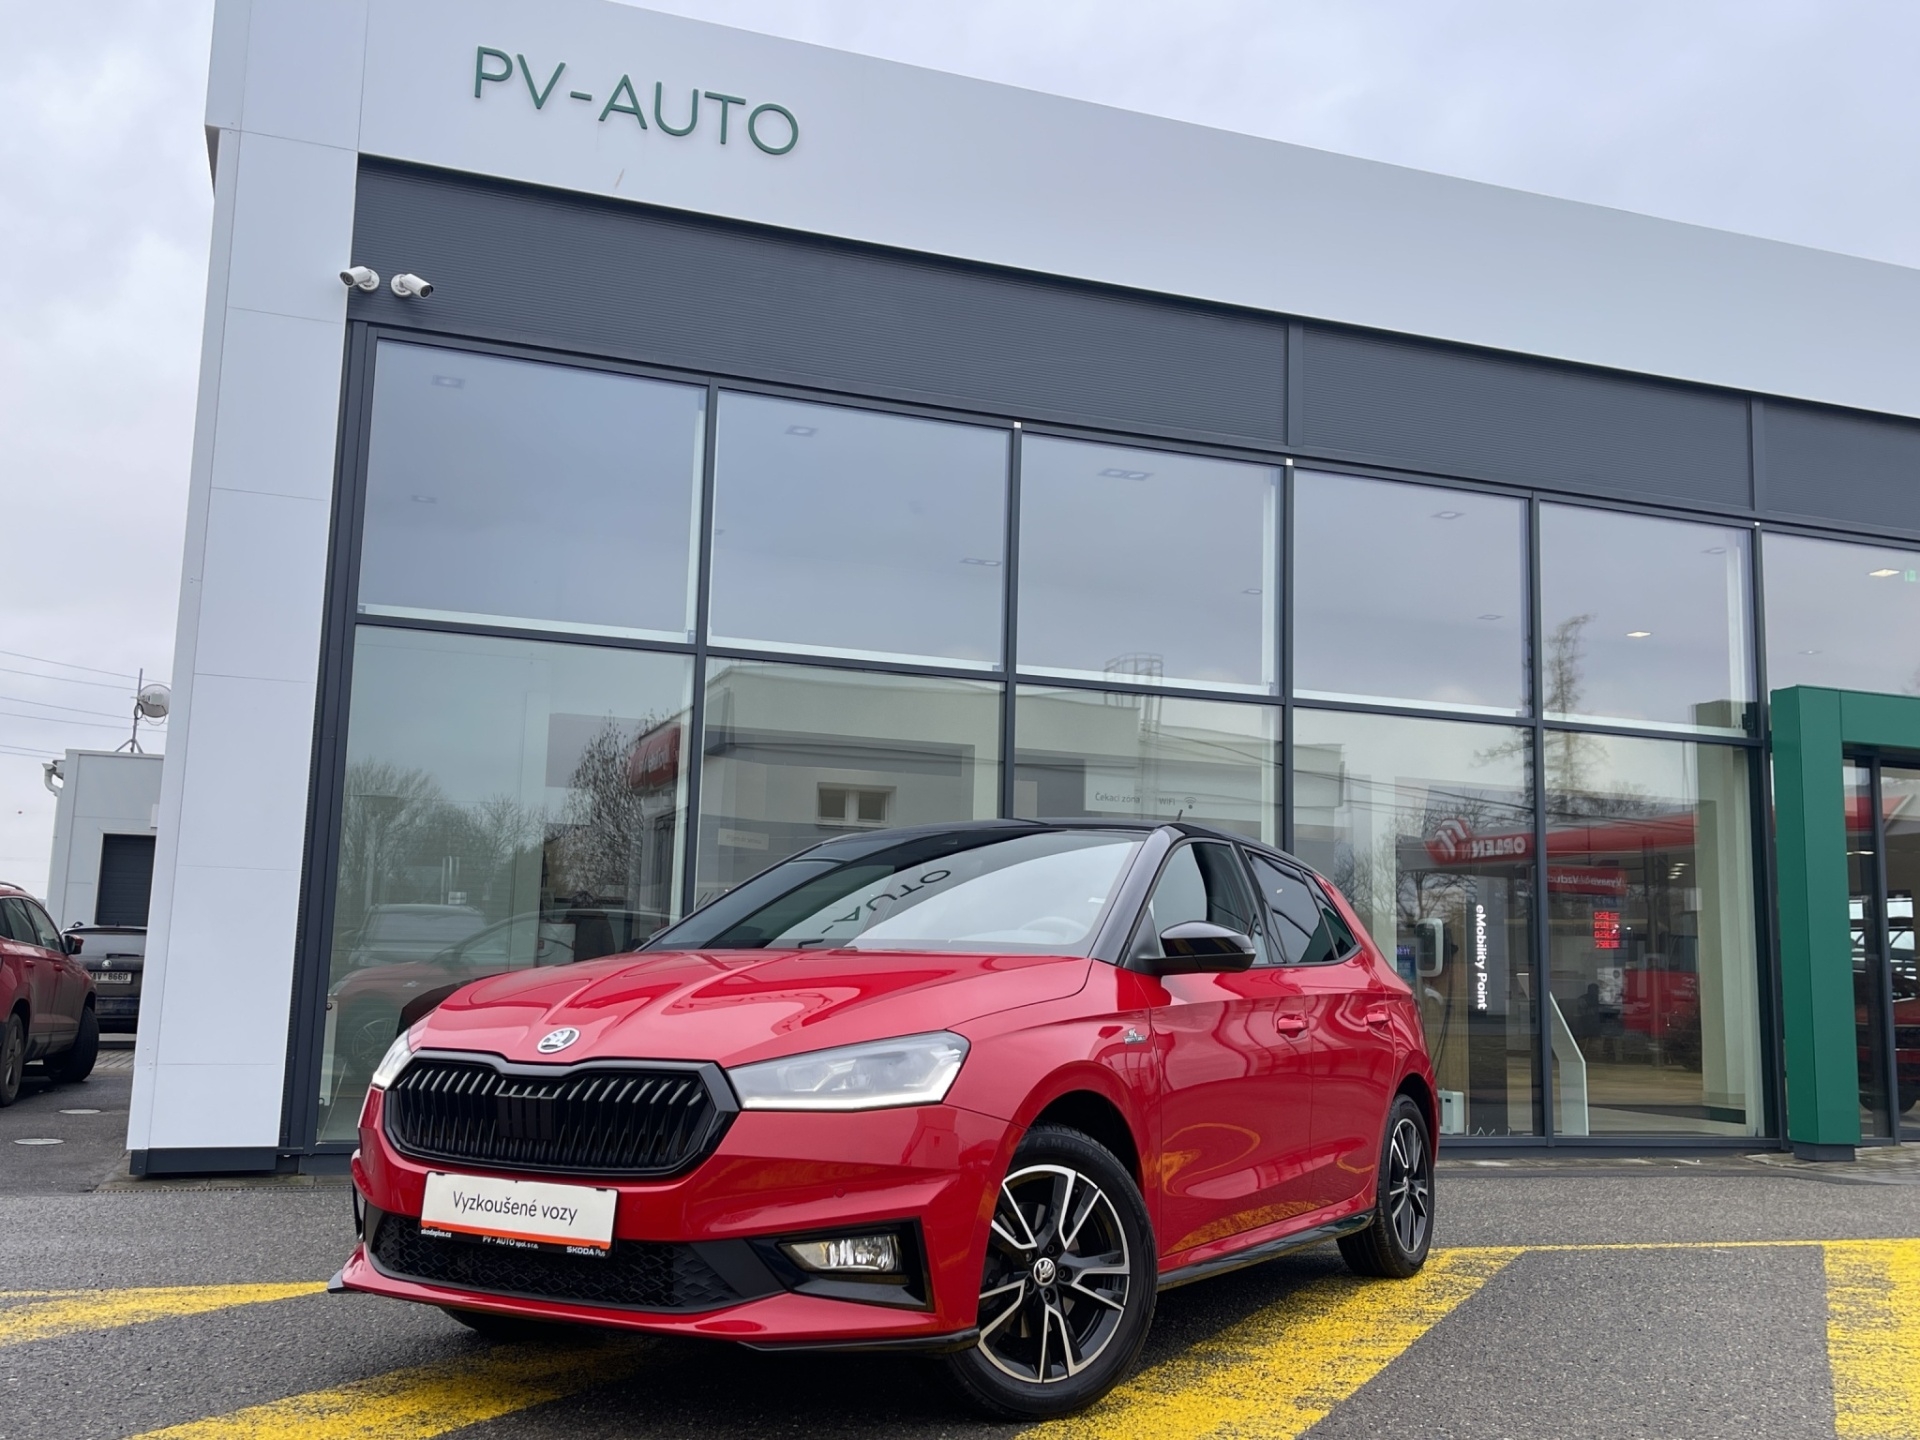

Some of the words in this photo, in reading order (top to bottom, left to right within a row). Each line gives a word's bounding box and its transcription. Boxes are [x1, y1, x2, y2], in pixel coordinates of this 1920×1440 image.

[474, 45, 799, 155] PV-AUTO
[1474, 904, 1487, 969] eMobility
[1477, 972, 1488, 1010] Point
[453, 1190, 537, 1218] Vyzkoušené
[541, 1204, 578, 1226] vozy
[496, 1236, 515, 1246] AUTO
